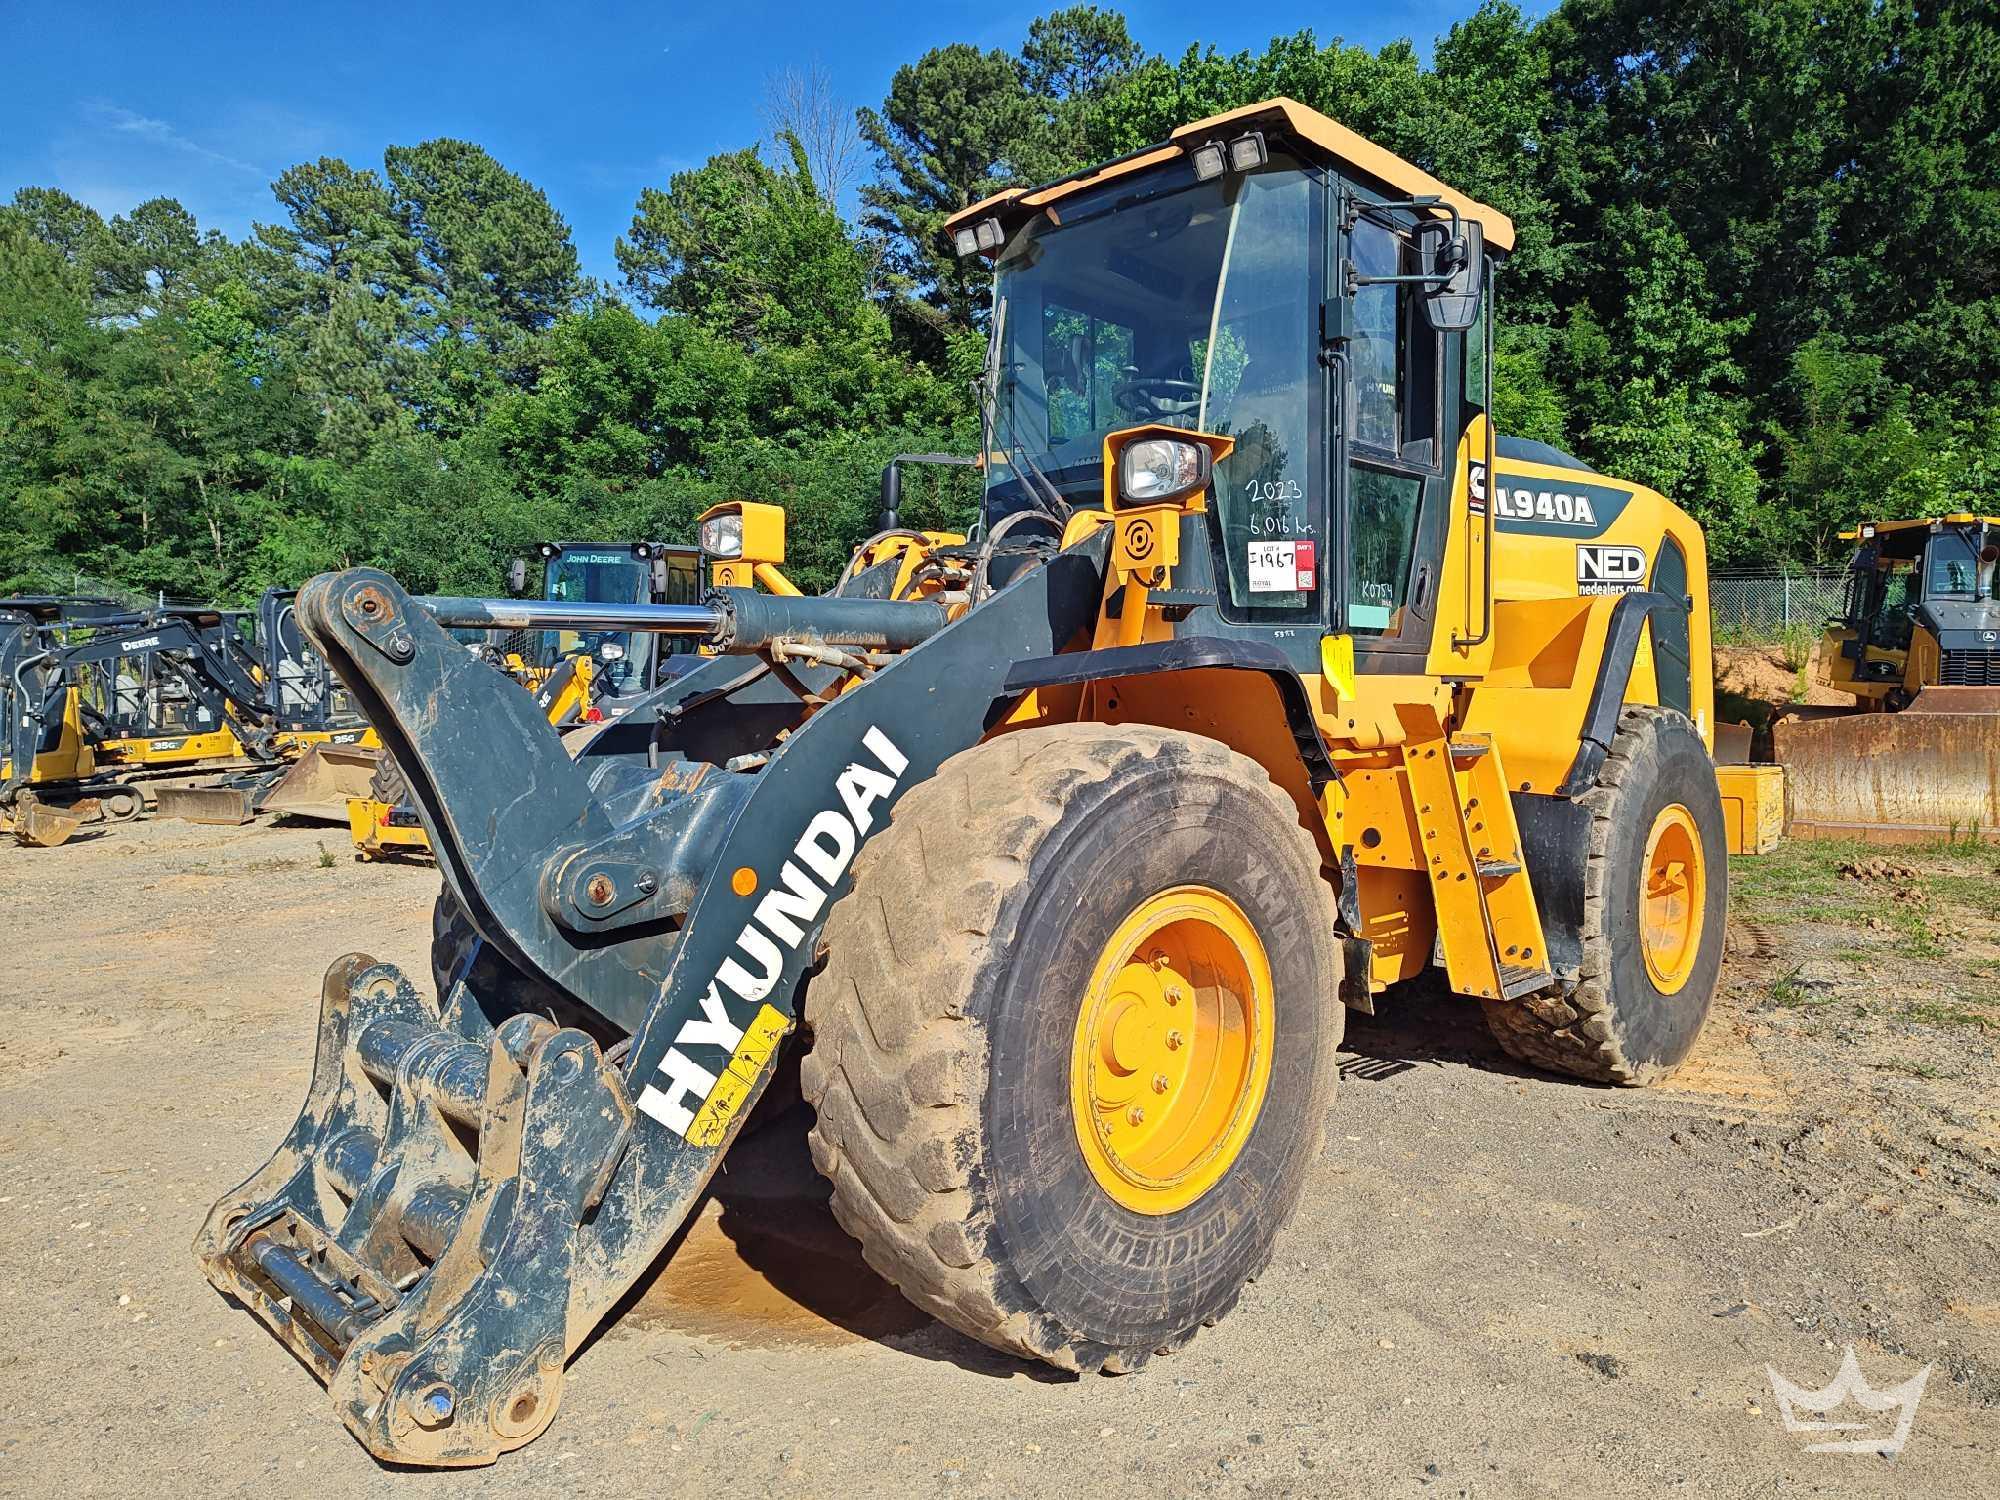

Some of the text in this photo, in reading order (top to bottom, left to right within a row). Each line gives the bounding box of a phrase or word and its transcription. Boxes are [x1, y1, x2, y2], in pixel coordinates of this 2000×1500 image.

[1245, 479, 1303, 503] 2023
[1249, 513, 1290, 537] 6,016
[566, 555, 622, 564] JOHN DEERE
[1579, 548, 1646, 580] NED
[1579, 582, 1646, 596] nedealers.com
[121, 636, 160, 651] DEERE
[153, 741, 178, 750] 35G
[334, 734, 355, 743] 35G
[636, 724, 910, 1137] HYUNDAI
